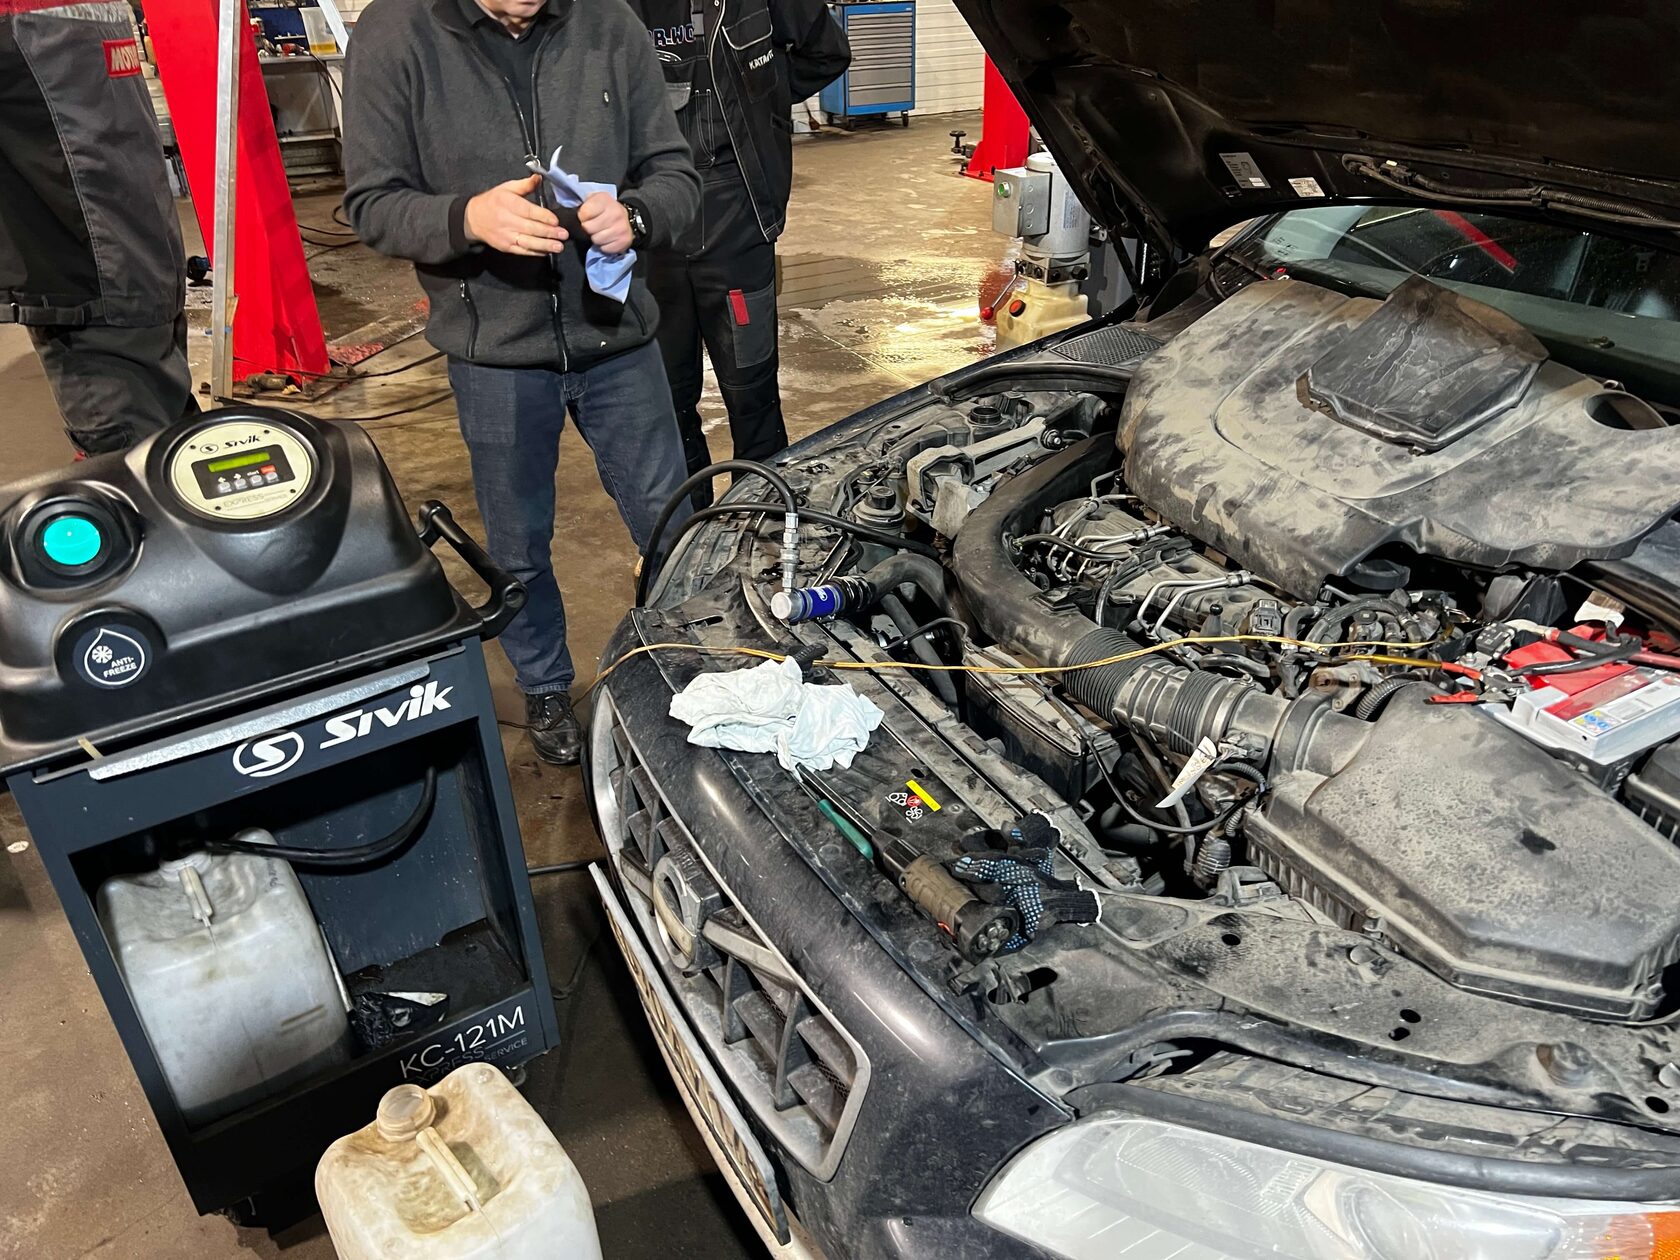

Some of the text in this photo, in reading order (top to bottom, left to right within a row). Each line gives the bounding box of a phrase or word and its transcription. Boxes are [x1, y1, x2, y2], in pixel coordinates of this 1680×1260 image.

[103, 661, 138, 678] FREEZE
[111, 656, 135, 668] ANTI-
[319, 680, 454, 750] Sivik
[400, 1005, 525, 1079] KC-121M
[484, 1036, 528, 1061] SERVICE
